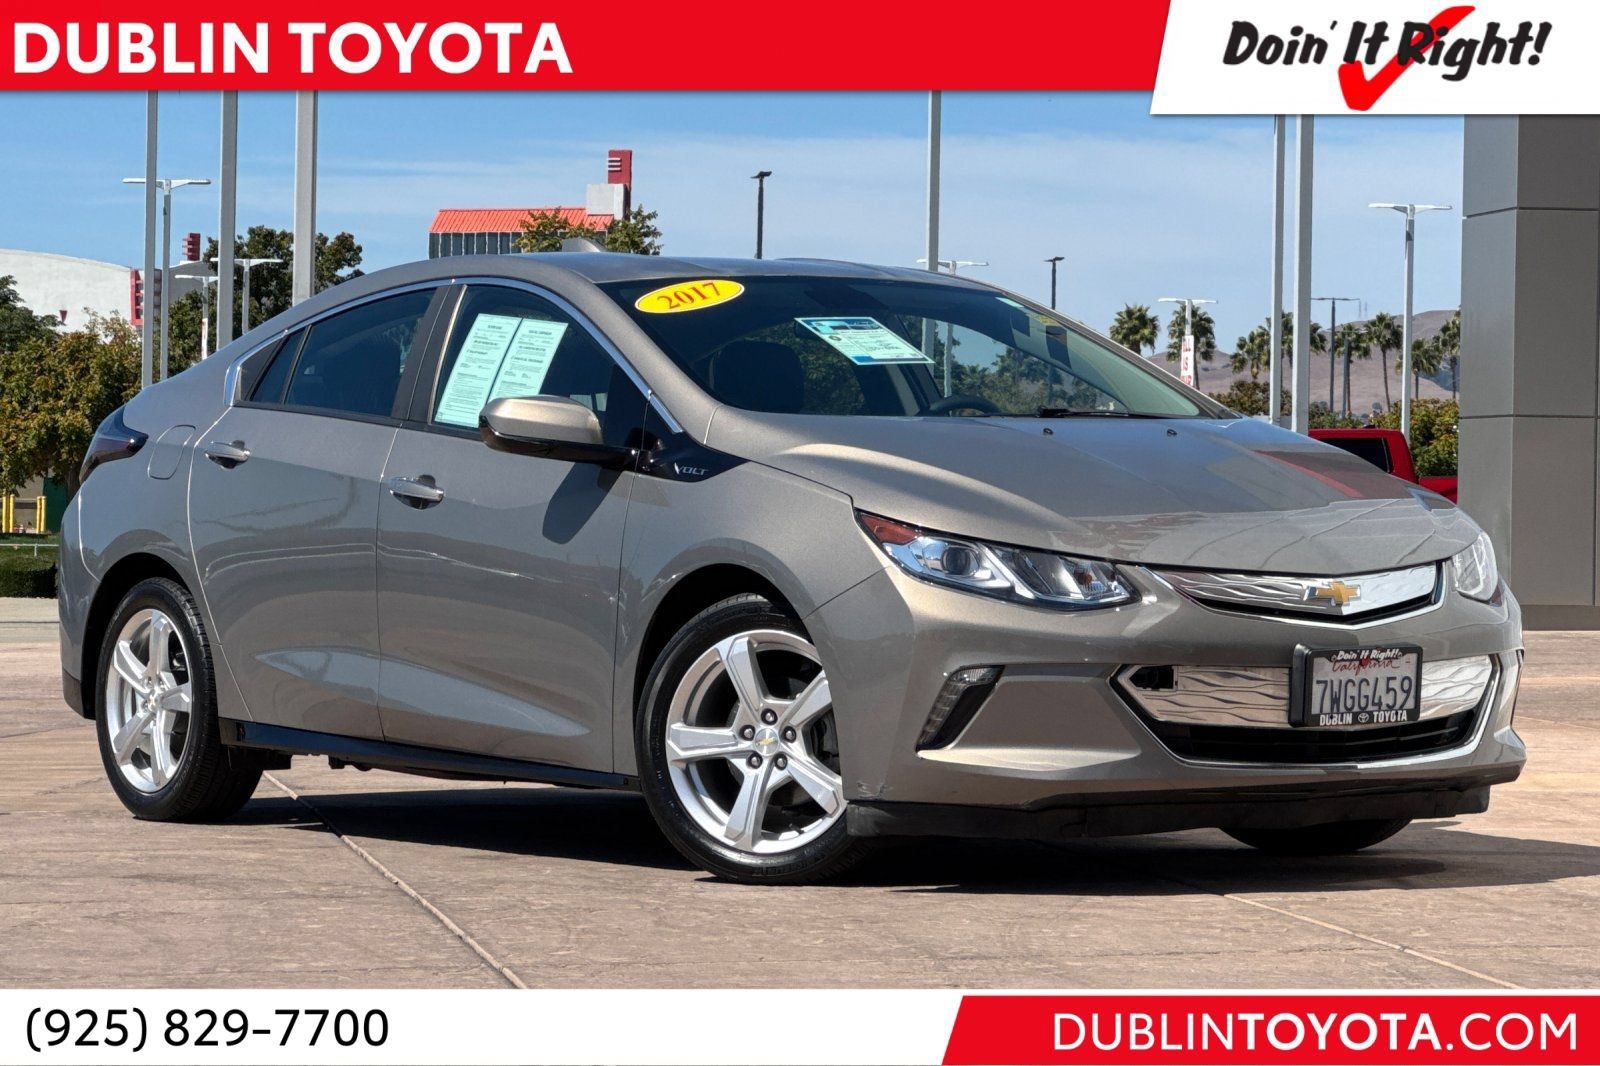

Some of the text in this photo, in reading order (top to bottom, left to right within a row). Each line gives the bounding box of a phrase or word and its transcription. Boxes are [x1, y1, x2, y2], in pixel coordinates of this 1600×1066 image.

[657, 281, 720, 309] 2017
[673, 462, 709, 476] VOLT
[1360, 650, 1368, 660] It
[1370, 648, 1400, 661] Right!
[1315, 675, 1413, 714] 7WGG459
[1320, 709, 1408, 726] DUBLIN TOYOTA
